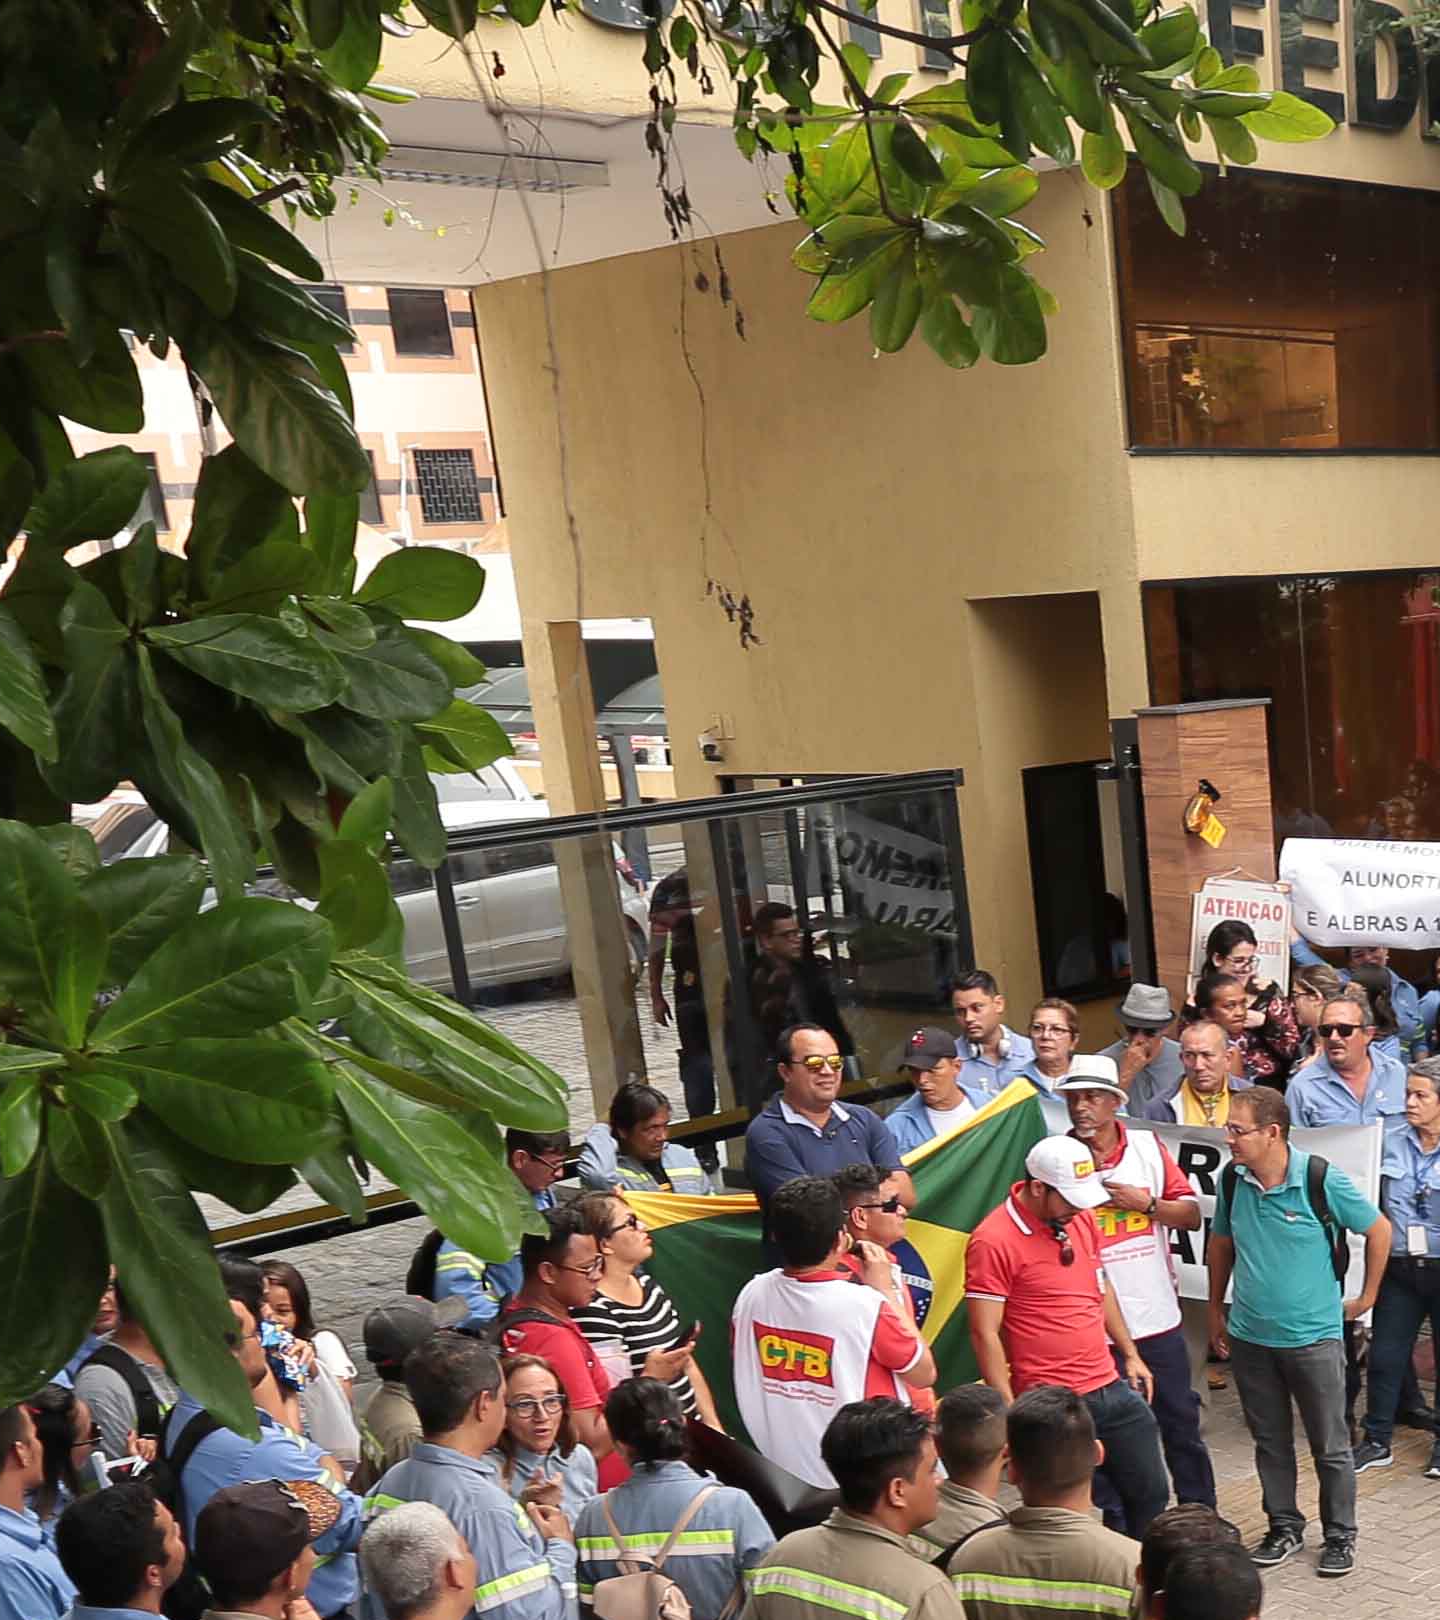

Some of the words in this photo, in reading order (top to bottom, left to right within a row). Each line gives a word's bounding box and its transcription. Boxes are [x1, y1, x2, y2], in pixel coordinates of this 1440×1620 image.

[1307, 911, 1318, 926] E
[1327, 914, 1408, 932] ALBRAS
[1413, 916, 1429, 932] A
[759, 1334, 829, 1378] CTB
